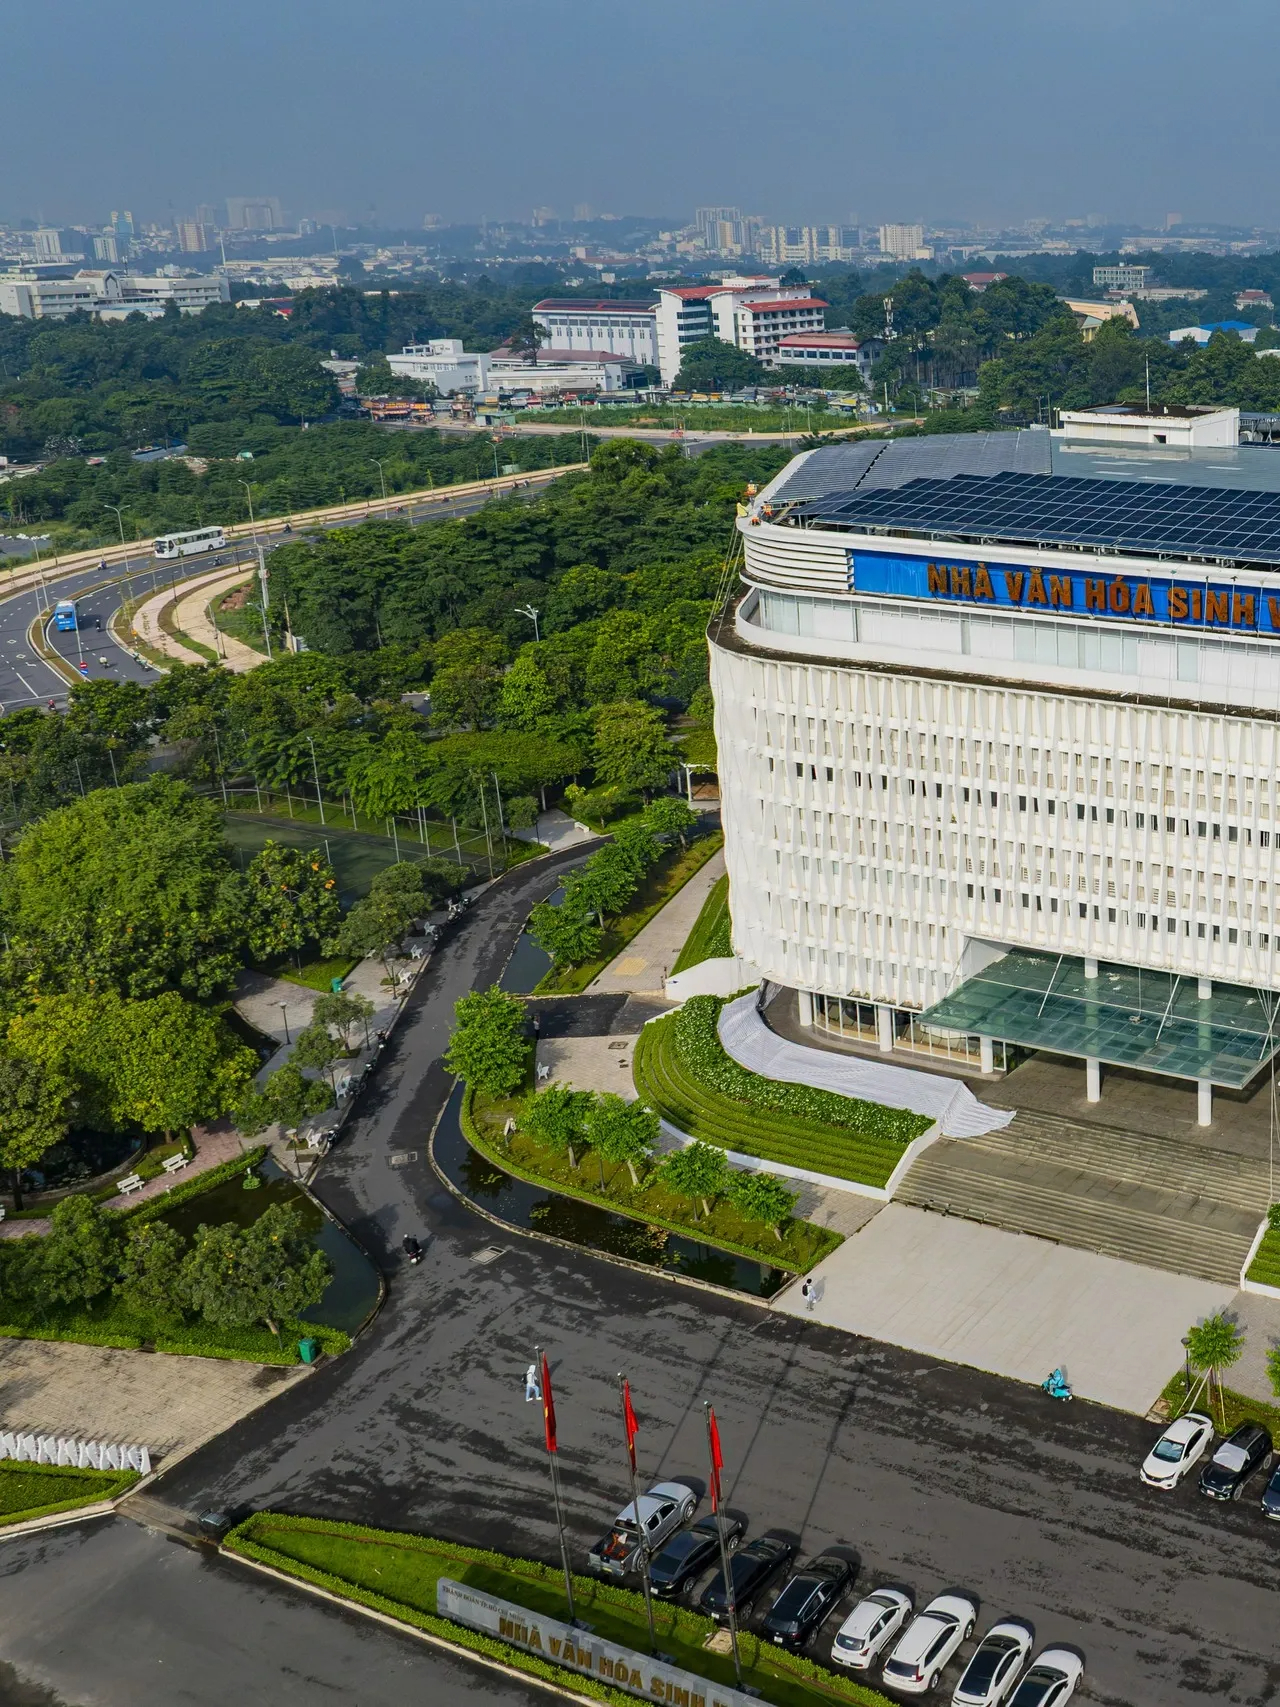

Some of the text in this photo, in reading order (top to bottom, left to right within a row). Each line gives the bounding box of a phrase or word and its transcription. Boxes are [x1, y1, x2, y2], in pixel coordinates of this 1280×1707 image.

[928, 562, 994, 599] NHÀ
[1004, 567, 1071, 607] VĂN
[1085, 575, 1155, 615] HÓA
[1167, 586, 1255, 625] SINH
[499, 1616, 706, 1707] NHÀ VĂN HÓA SINH
